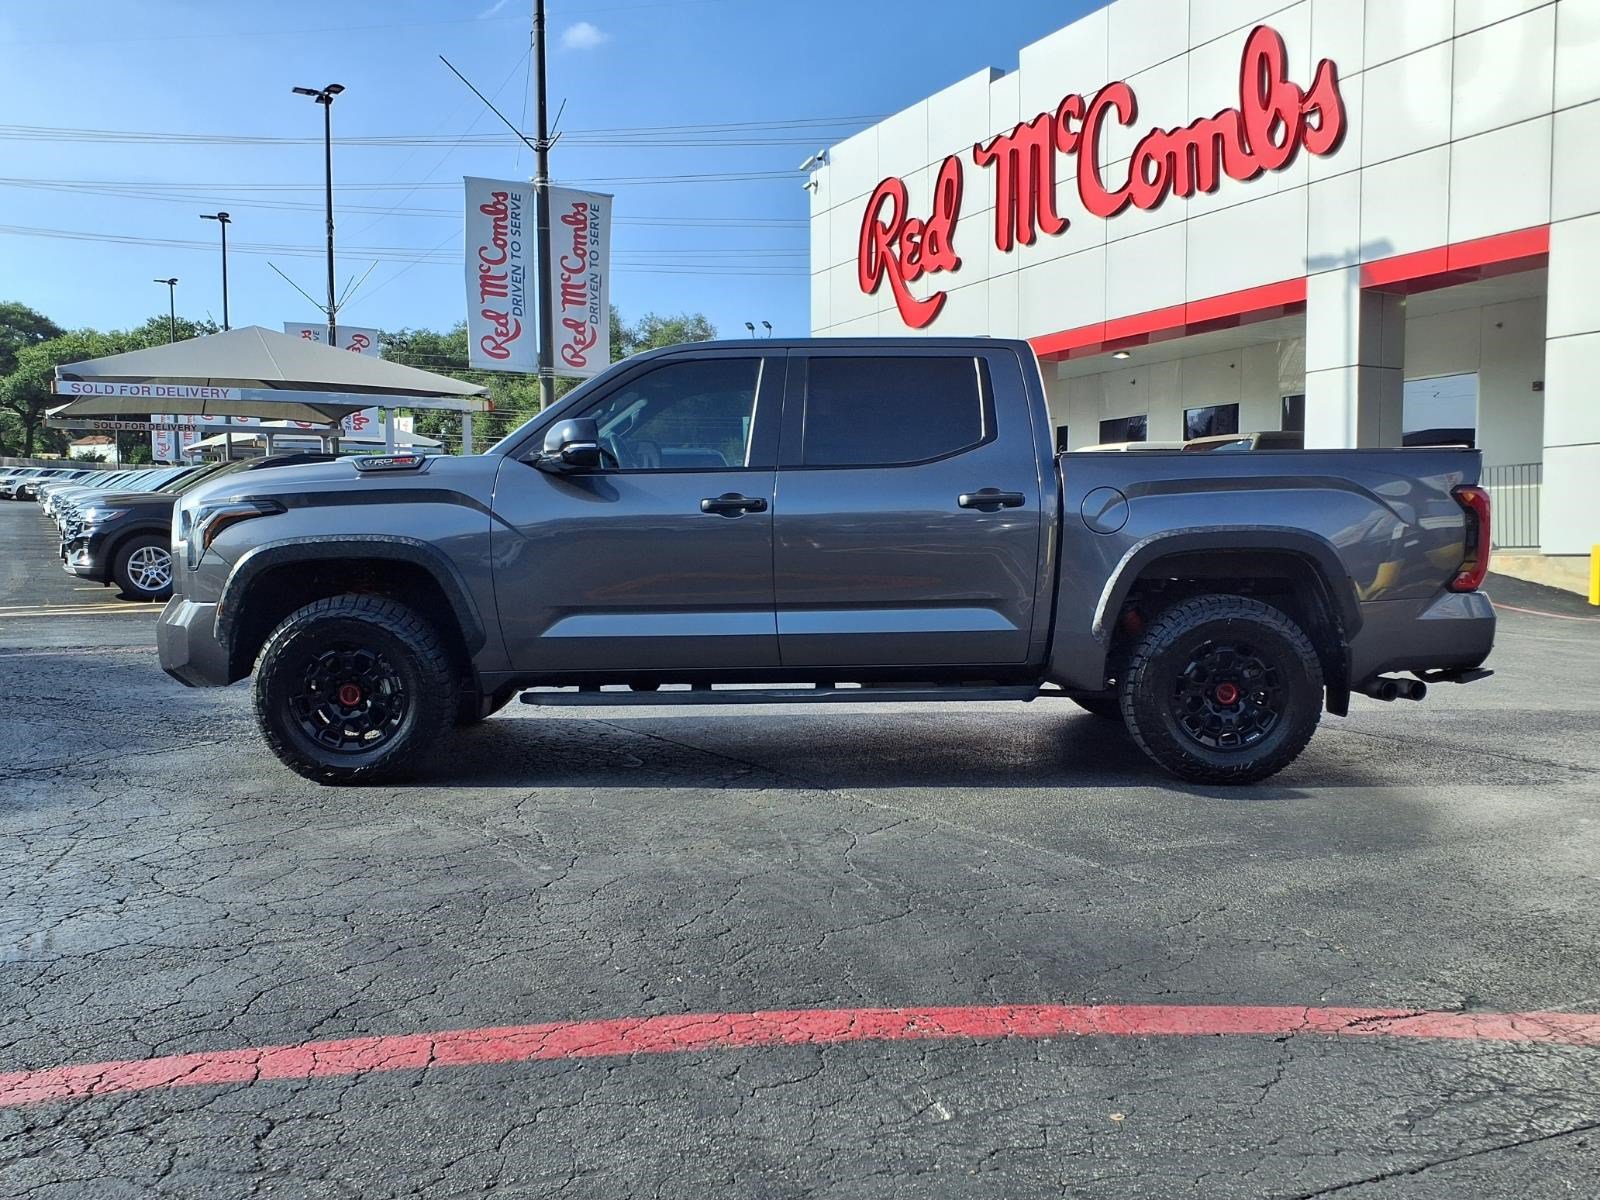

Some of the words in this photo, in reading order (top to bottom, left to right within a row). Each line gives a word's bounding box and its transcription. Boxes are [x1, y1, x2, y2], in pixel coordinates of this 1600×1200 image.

[858, 155, 964, 329] Red
[973, 25, 1348, 252] McCombs
[511, 192, 522, 237] SERVE
[589, 203, 599, 247] SERVE
[479, 191, 509, 304] McCombs
[511, 241, 521, 260] TO
[560, 202, 588, 312] McCombs
[589, 250, 599, 269] TO
[511, 265, 523, 317] DRIVEN
[589, 273, 599, 325] DRIVEN
[345, 333, 371, 353] Re
[480, 309, 522, 360] Red
[561, 318, 597, 368] Red
[71, 382, 115, 395] SOLD
[119, 385, 151, 396] FOR
[156, 386, 230, 399] DELIVERY
[94, 421, 122, 430] SOLD
[125, 422, 146, 430] FOR
[149, 423, 198, 432] DELIVERY
